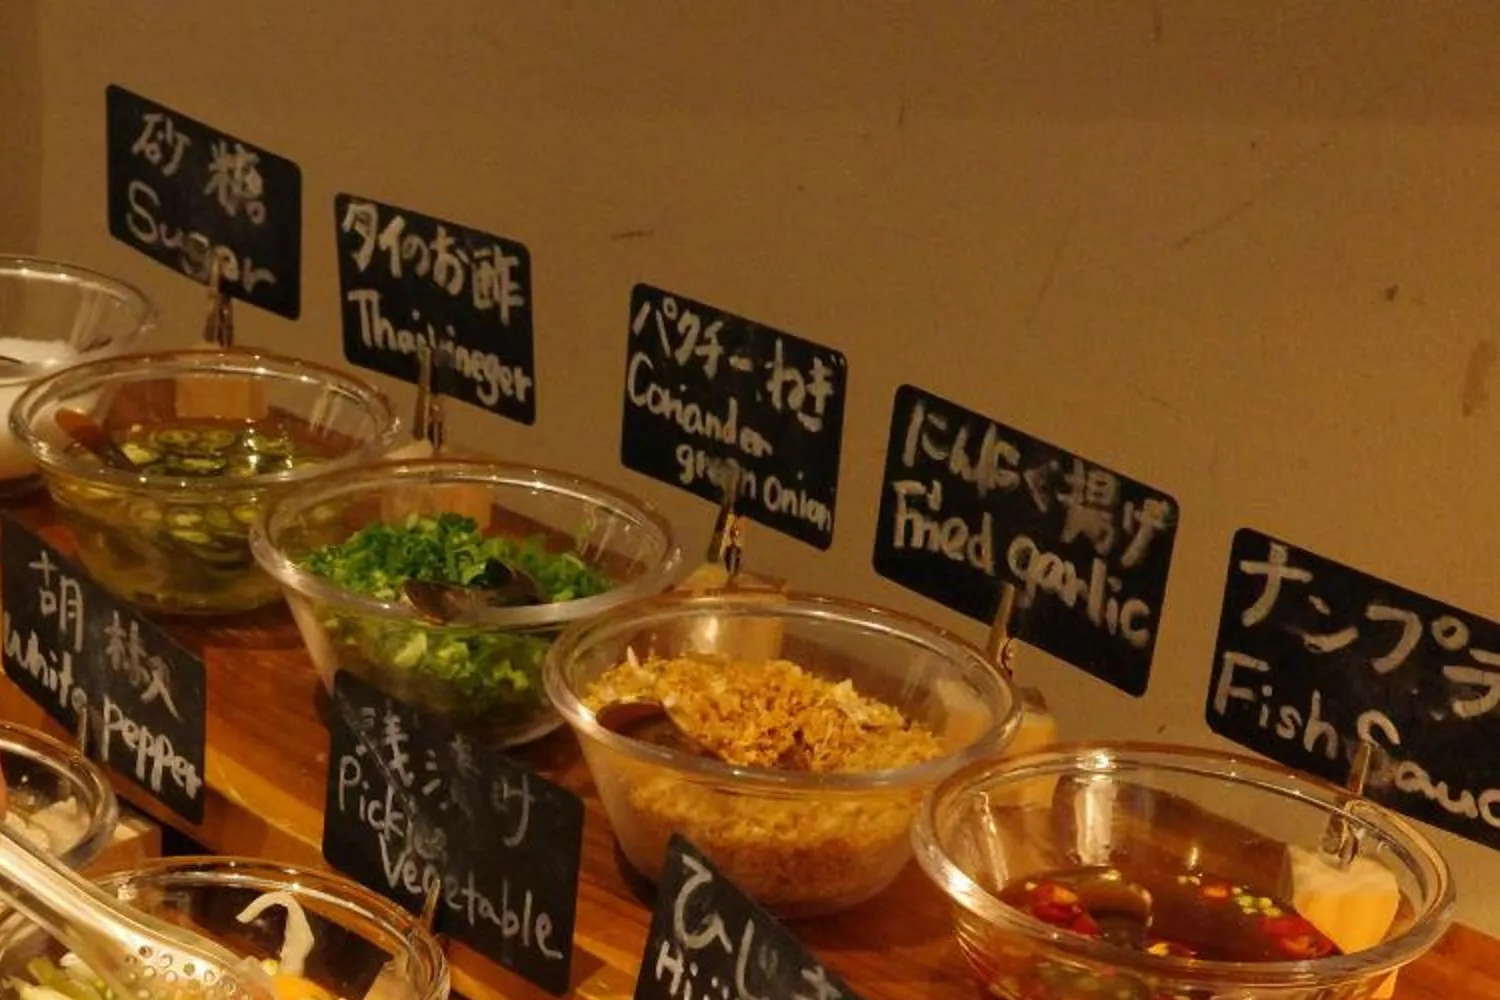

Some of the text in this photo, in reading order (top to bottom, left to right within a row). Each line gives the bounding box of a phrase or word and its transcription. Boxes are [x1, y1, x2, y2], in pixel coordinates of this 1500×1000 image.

[131, 113, 267, 225] 砂糖
[126, 180, 277, 293] Sugar
[1213, 651, 1339, 761] Fish
